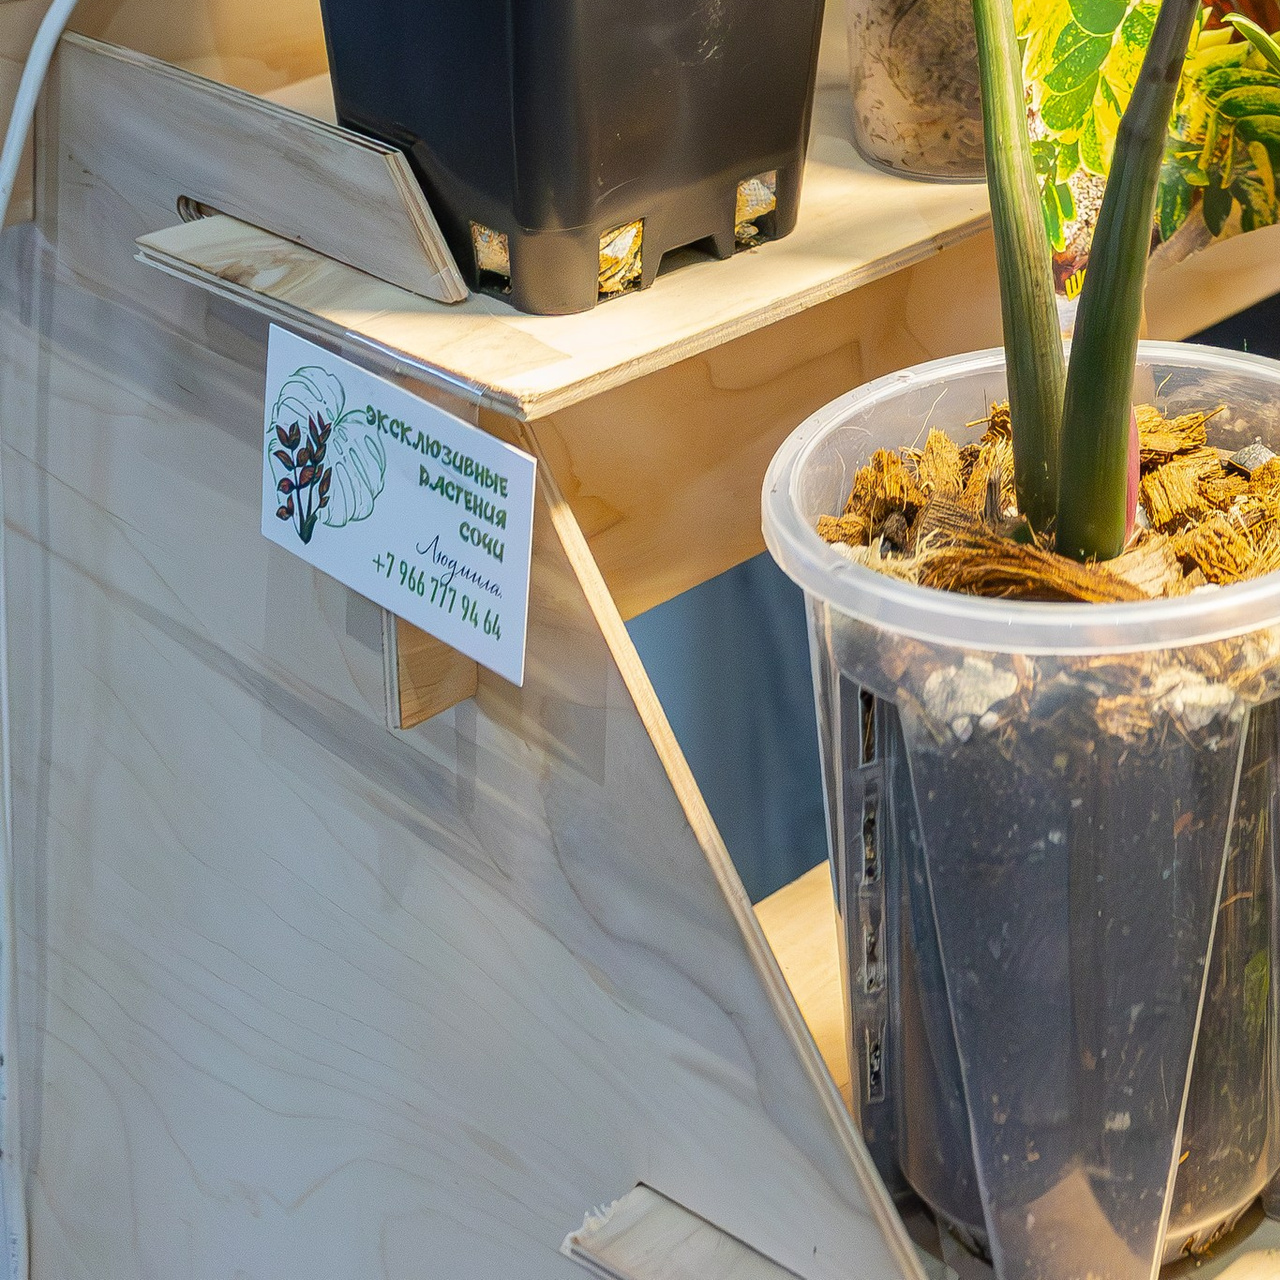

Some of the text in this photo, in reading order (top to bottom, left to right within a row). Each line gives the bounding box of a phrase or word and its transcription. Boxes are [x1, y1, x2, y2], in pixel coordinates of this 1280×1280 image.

[365, 404, 509, 499] ЭКСКЛЮЗИВНЫЕ
[419, 464, 508, 531] РАСТЕНИЯ
[458, 520, 505, 563] СОЧИ
[372, 551, 502, 642] +7 966 777 94 64
